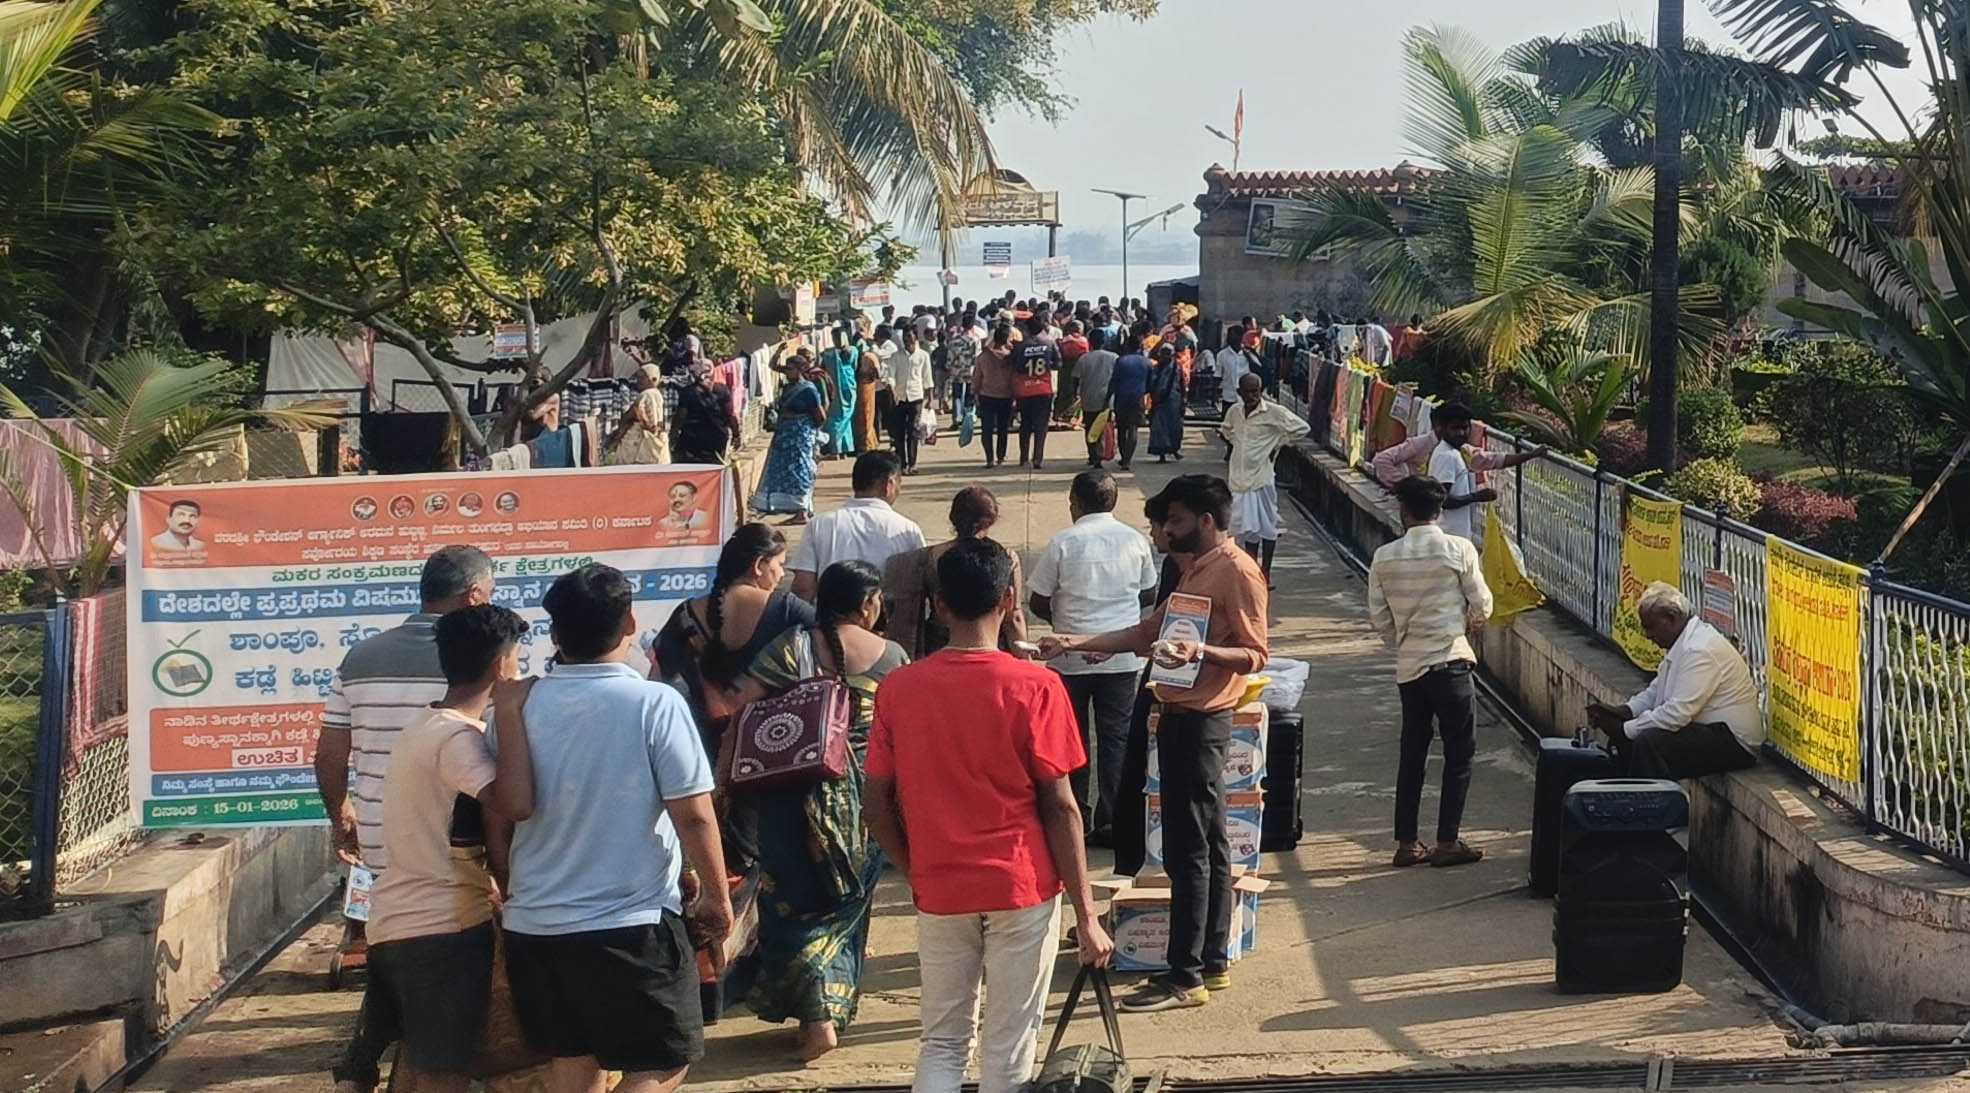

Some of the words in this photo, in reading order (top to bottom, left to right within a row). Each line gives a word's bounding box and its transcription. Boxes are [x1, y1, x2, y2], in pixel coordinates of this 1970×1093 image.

[1025, 358, 1046, 376] 18
[272, 567, 321, 582] ಮಕರ
[327, 563, 423, 582] ಸಂಕ್ರಮಣದ
[159, 591, 251, 619] ದೇಶದಲ್ಲೇ
[256, 588, 347, 617] ಪ್ರಪ್ರಥಮ
[351, 585, 422, 607] ವಿಷಮು
[659, 573, 708, 592] 2026
[292, 667, 334, 697] ಹಿಟ್ಟಿ
[163, 715, 209, 727] ನಾಡಿನ
[210, 710, 316, 728] ತೀರ್ಥಕ್ಷೇತ್ರಗಳಲ್ಲಿ
[237, 748, 298, 766] ಉಚಿತ
[215, 776, 248, 788] ಹಾಗೂ
[249, 775, 276, 789] ನಮ್ಮ
[276, 772, 316, 787] ಫೌಂಡೇ
[151, 804, 198, 818] ದಿನಾಂಕ
[213, 798, 299, 815] 15-01-2026
